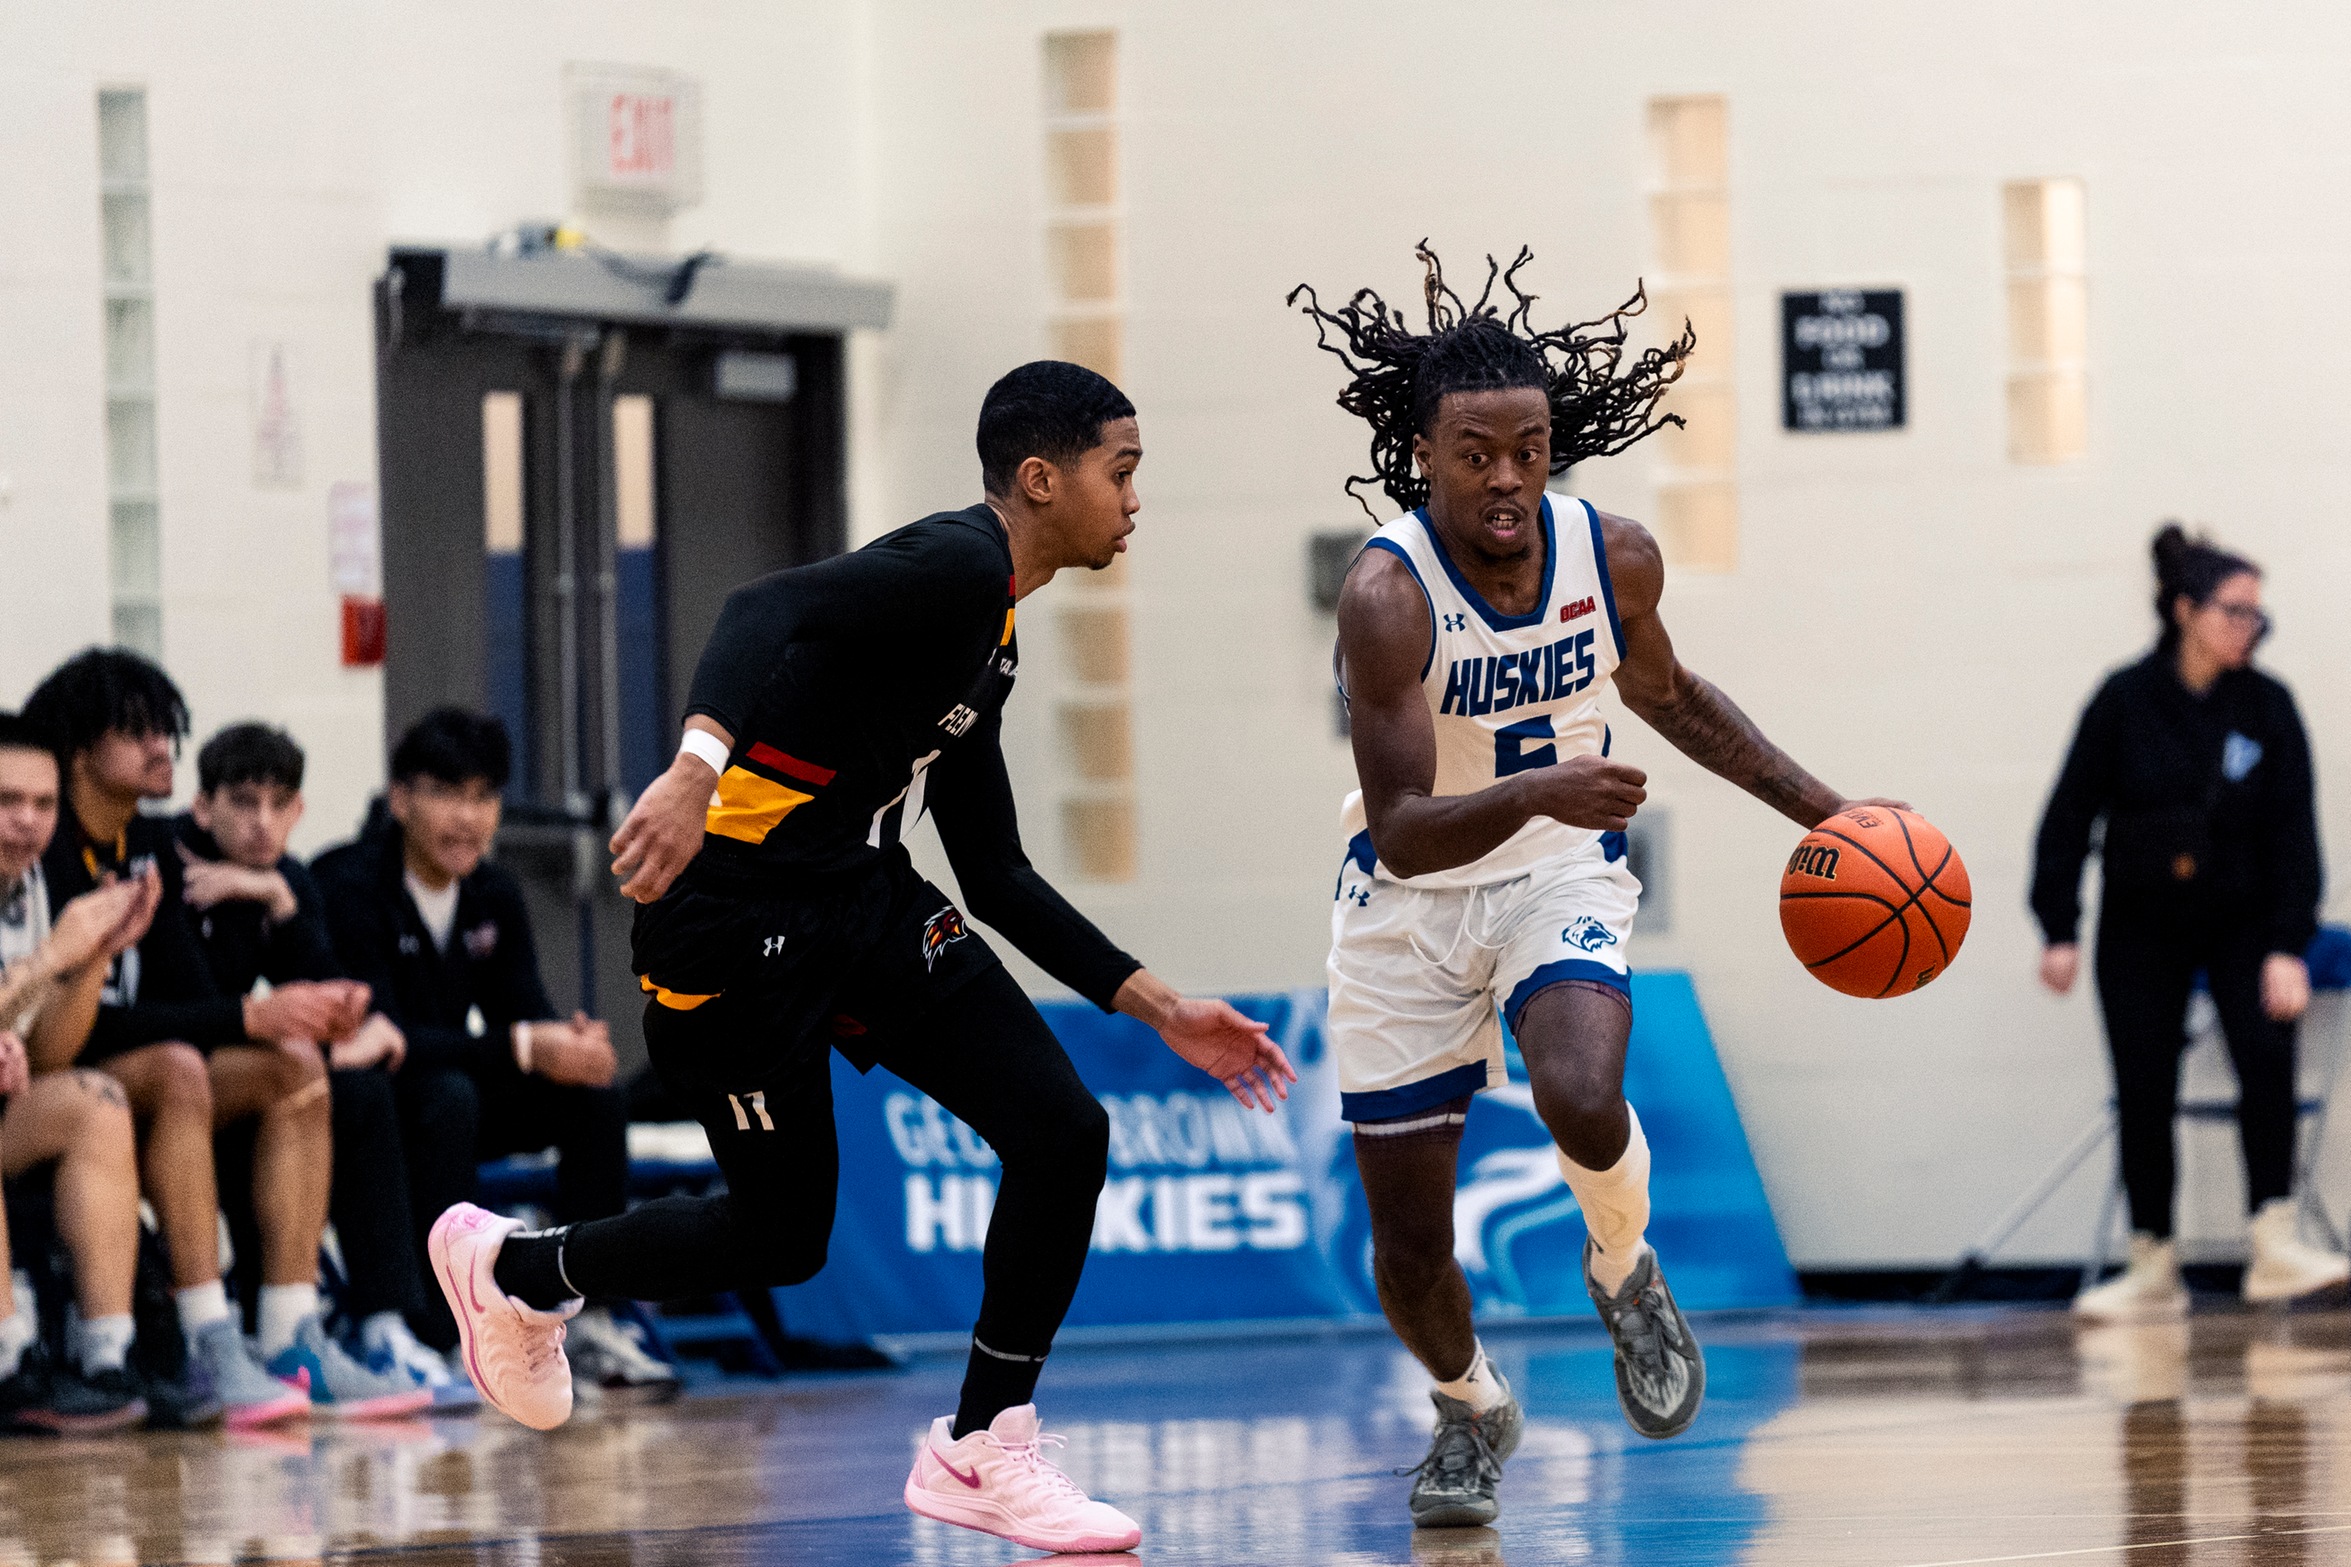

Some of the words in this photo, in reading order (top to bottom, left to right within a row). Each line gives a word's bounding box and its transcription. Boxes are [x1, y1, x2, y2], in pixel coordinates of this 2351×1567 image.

[1560, 595, 1596, 624] OCAA
[1440, 628, 1595, 717] HUSKIES
[904, 1174, 1304, 1251] HUKIES
